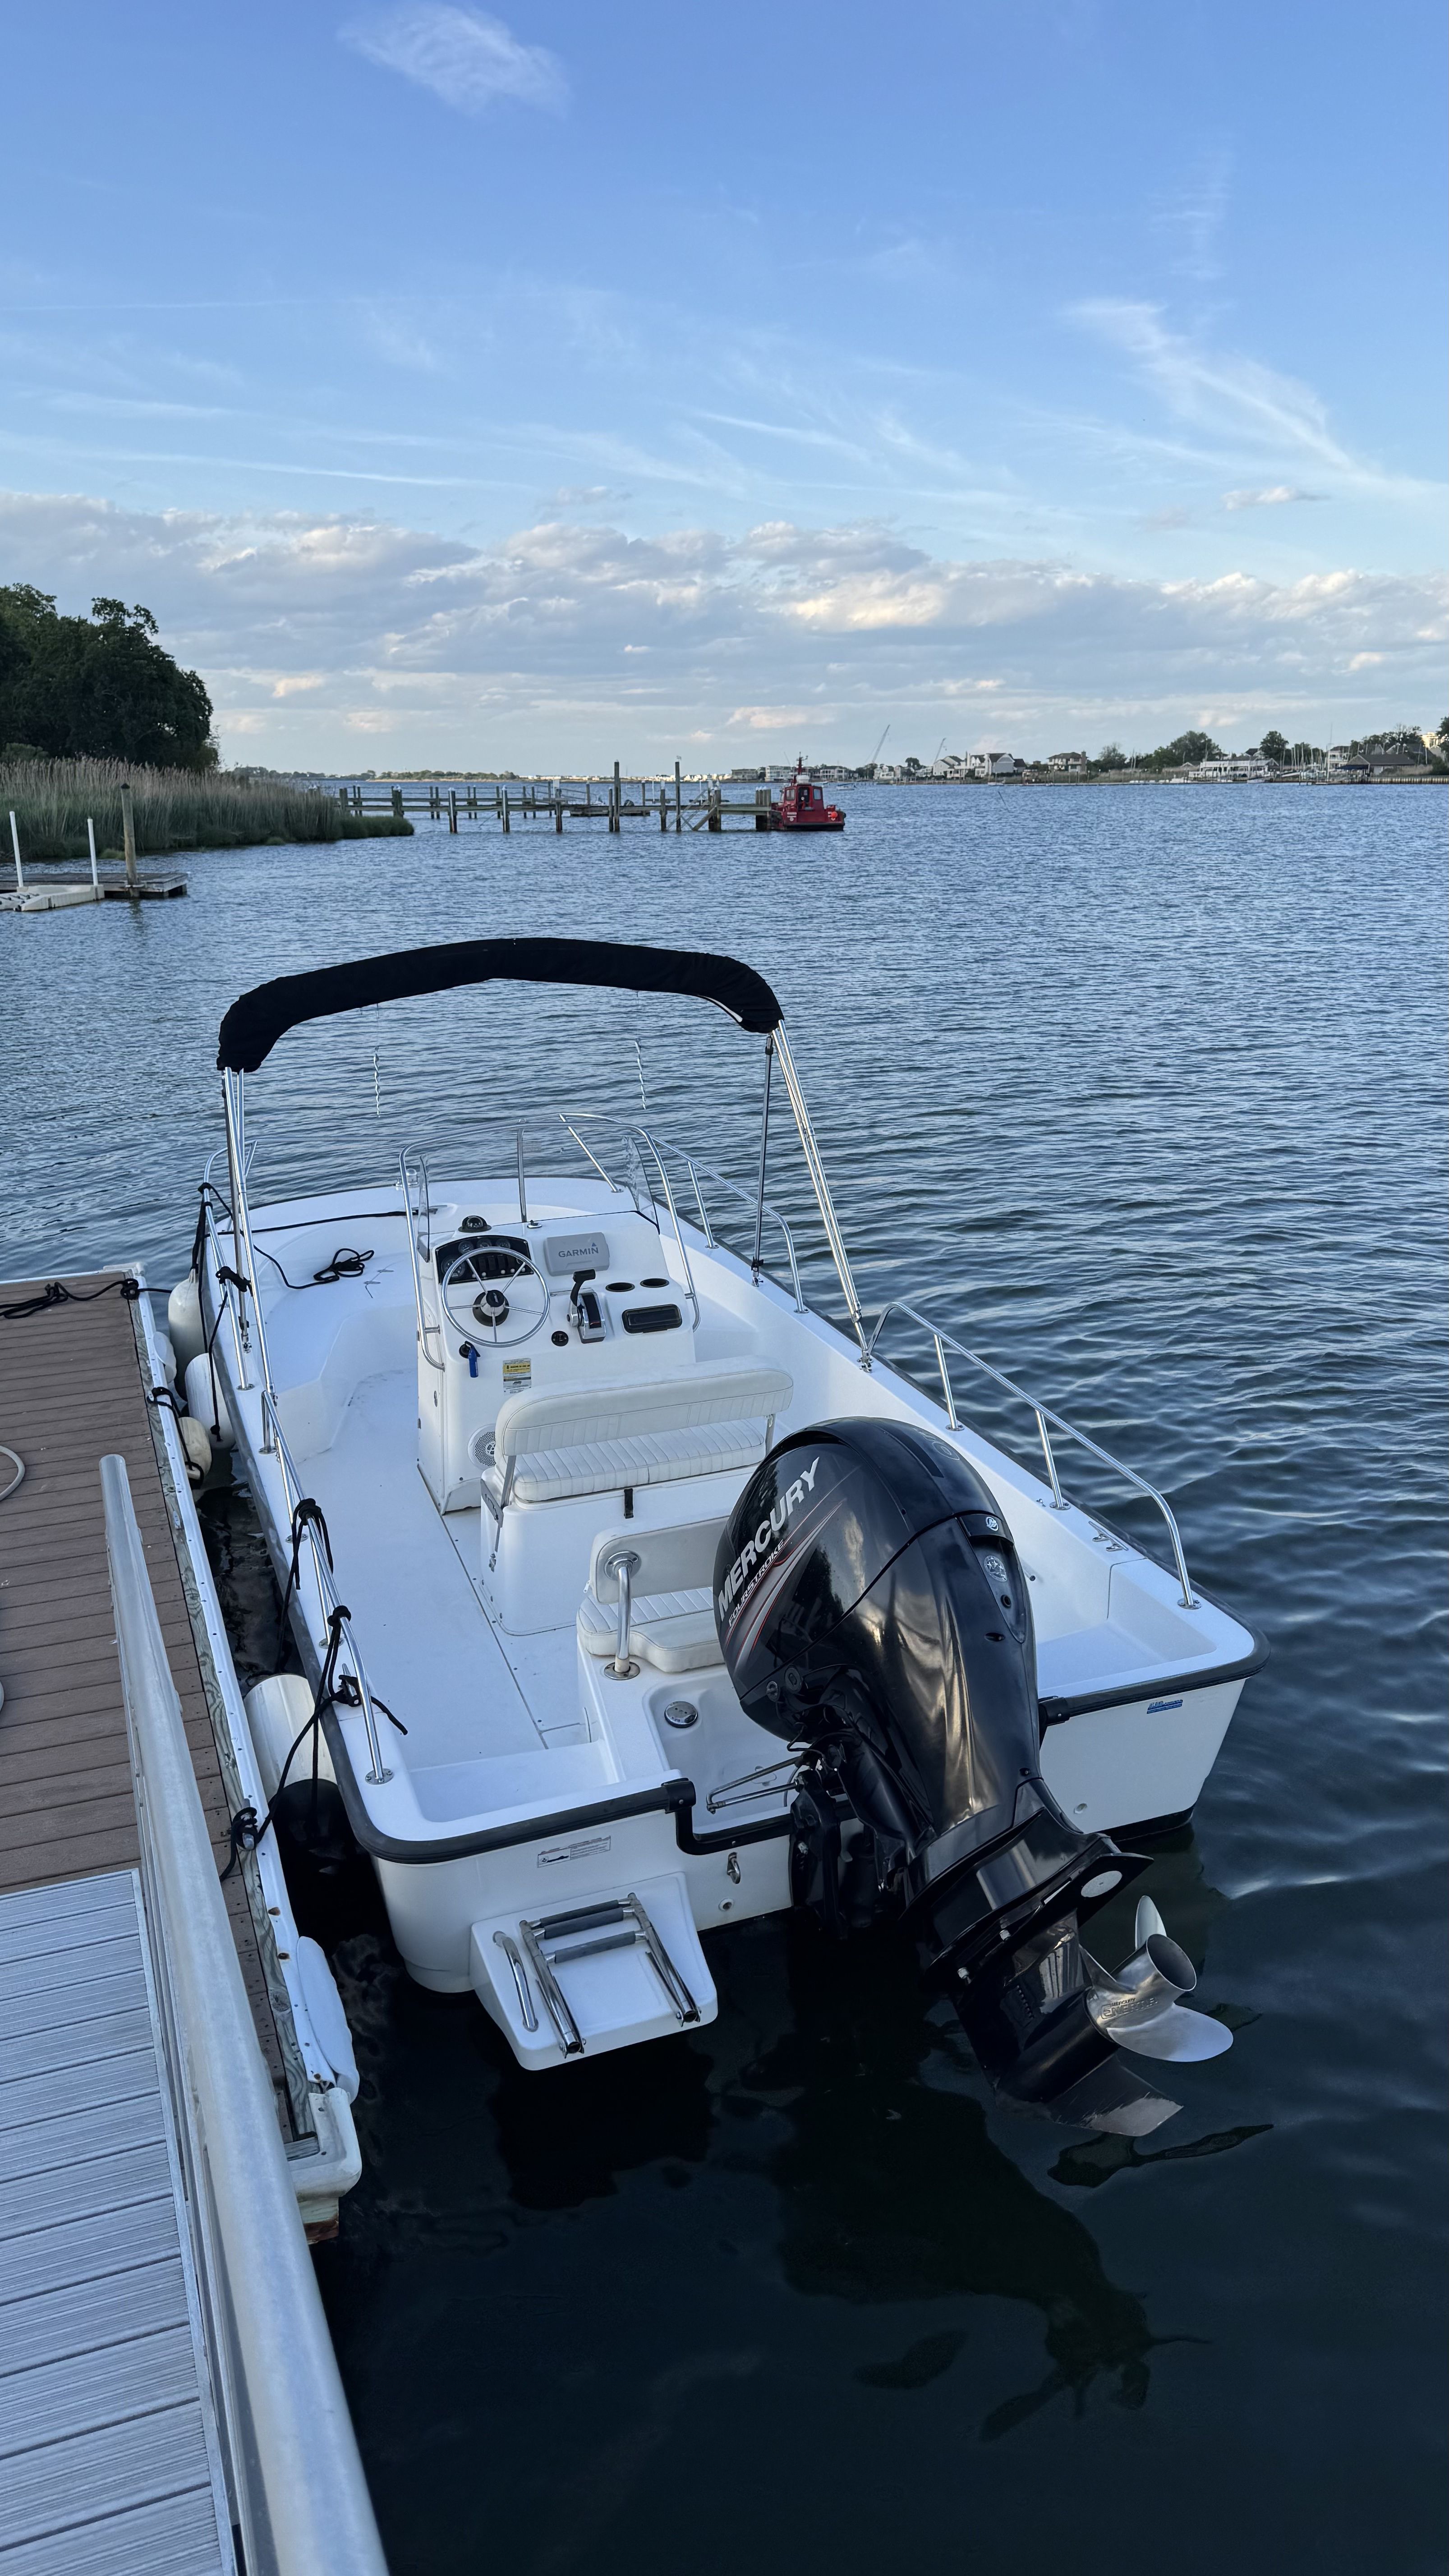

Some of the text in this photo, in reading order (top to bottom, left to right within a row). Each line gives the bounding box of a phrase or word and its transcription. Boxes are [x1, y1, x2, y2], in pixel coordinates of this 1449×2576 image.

[558, 1247, 599, 1257] GARMIN
[718, 1456, 819, 1622] MERCURY
[728, 1539, 785, 1627] FOURSTROKE
